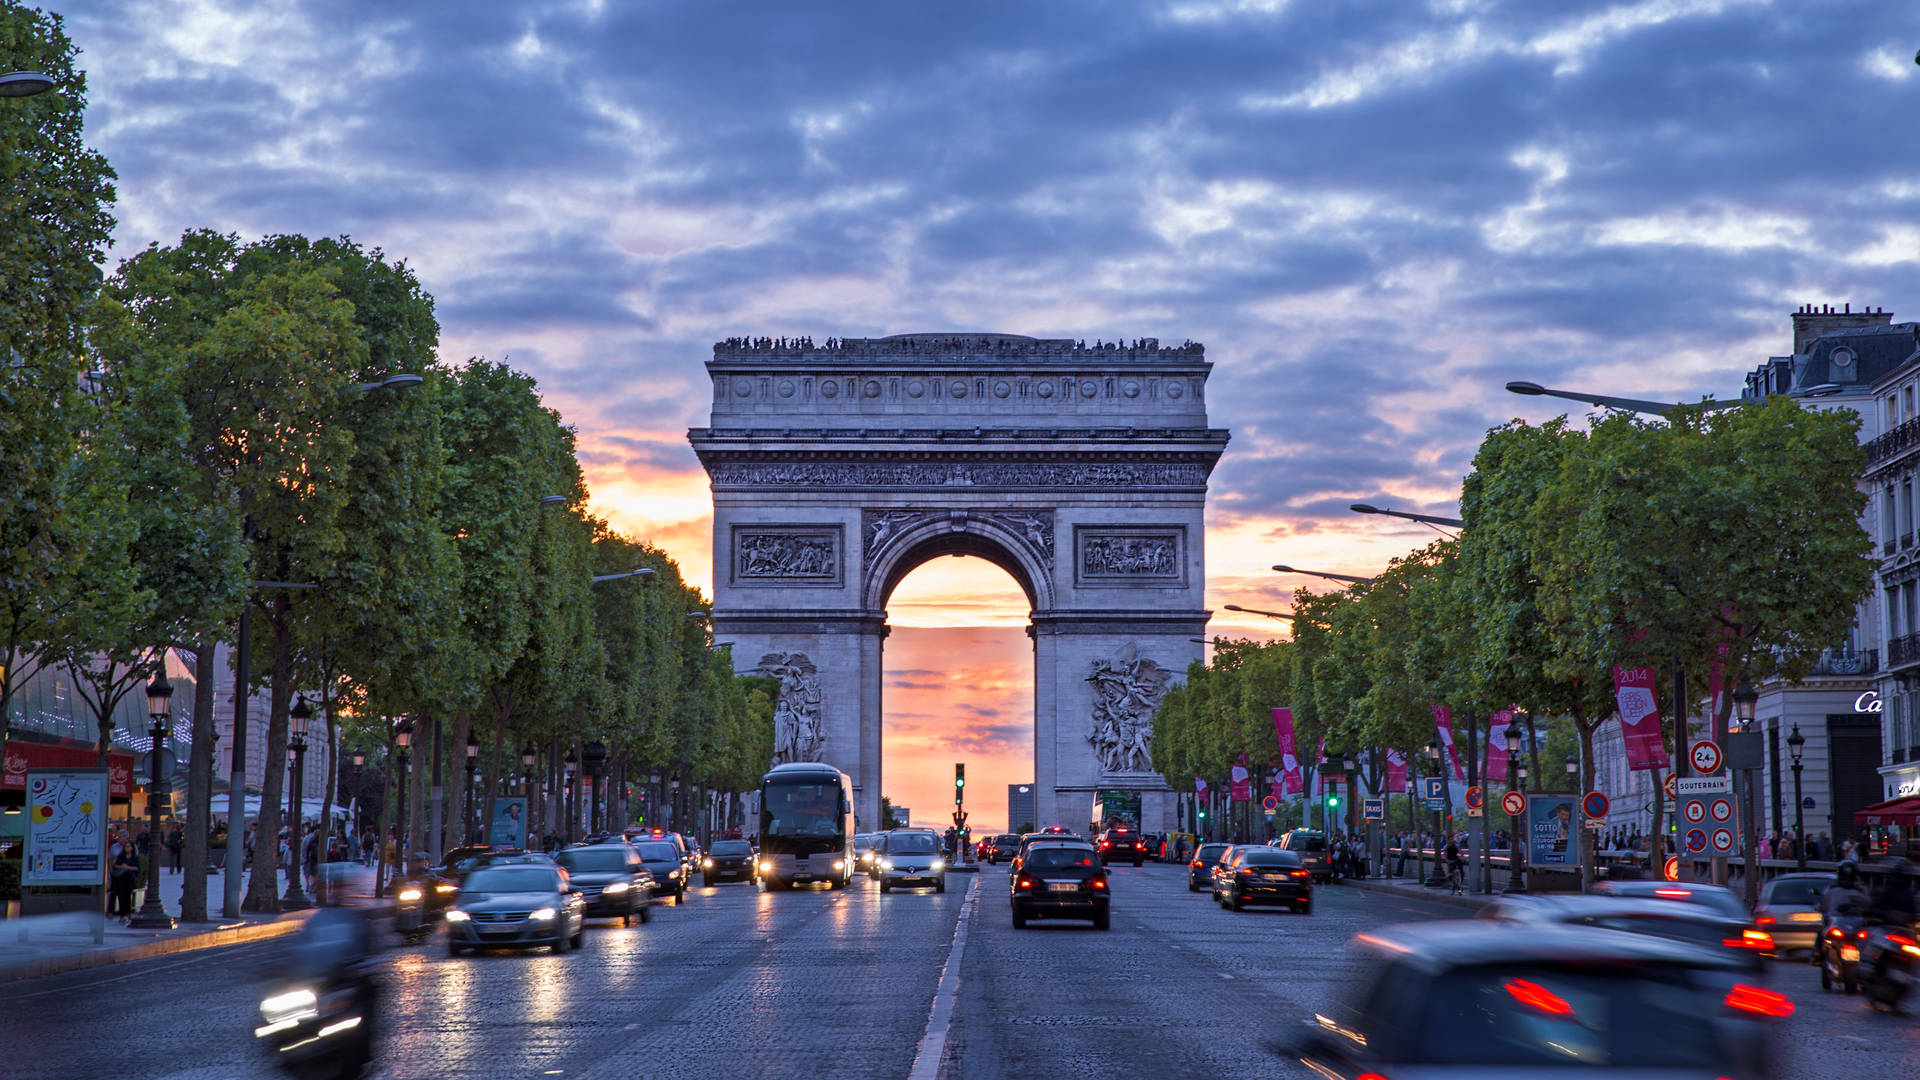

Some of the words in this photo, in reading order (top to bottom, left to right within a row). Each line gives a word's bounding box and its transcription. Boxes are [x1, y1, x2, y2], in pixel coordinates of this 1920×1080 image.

[1620, 669, 1647, 683] 2014
[1432, 782, 1442, 796] P
[1680, 782, 1724, 790] SOUTERRAIN
[1366, 805, 1381, 813] TAXIS
